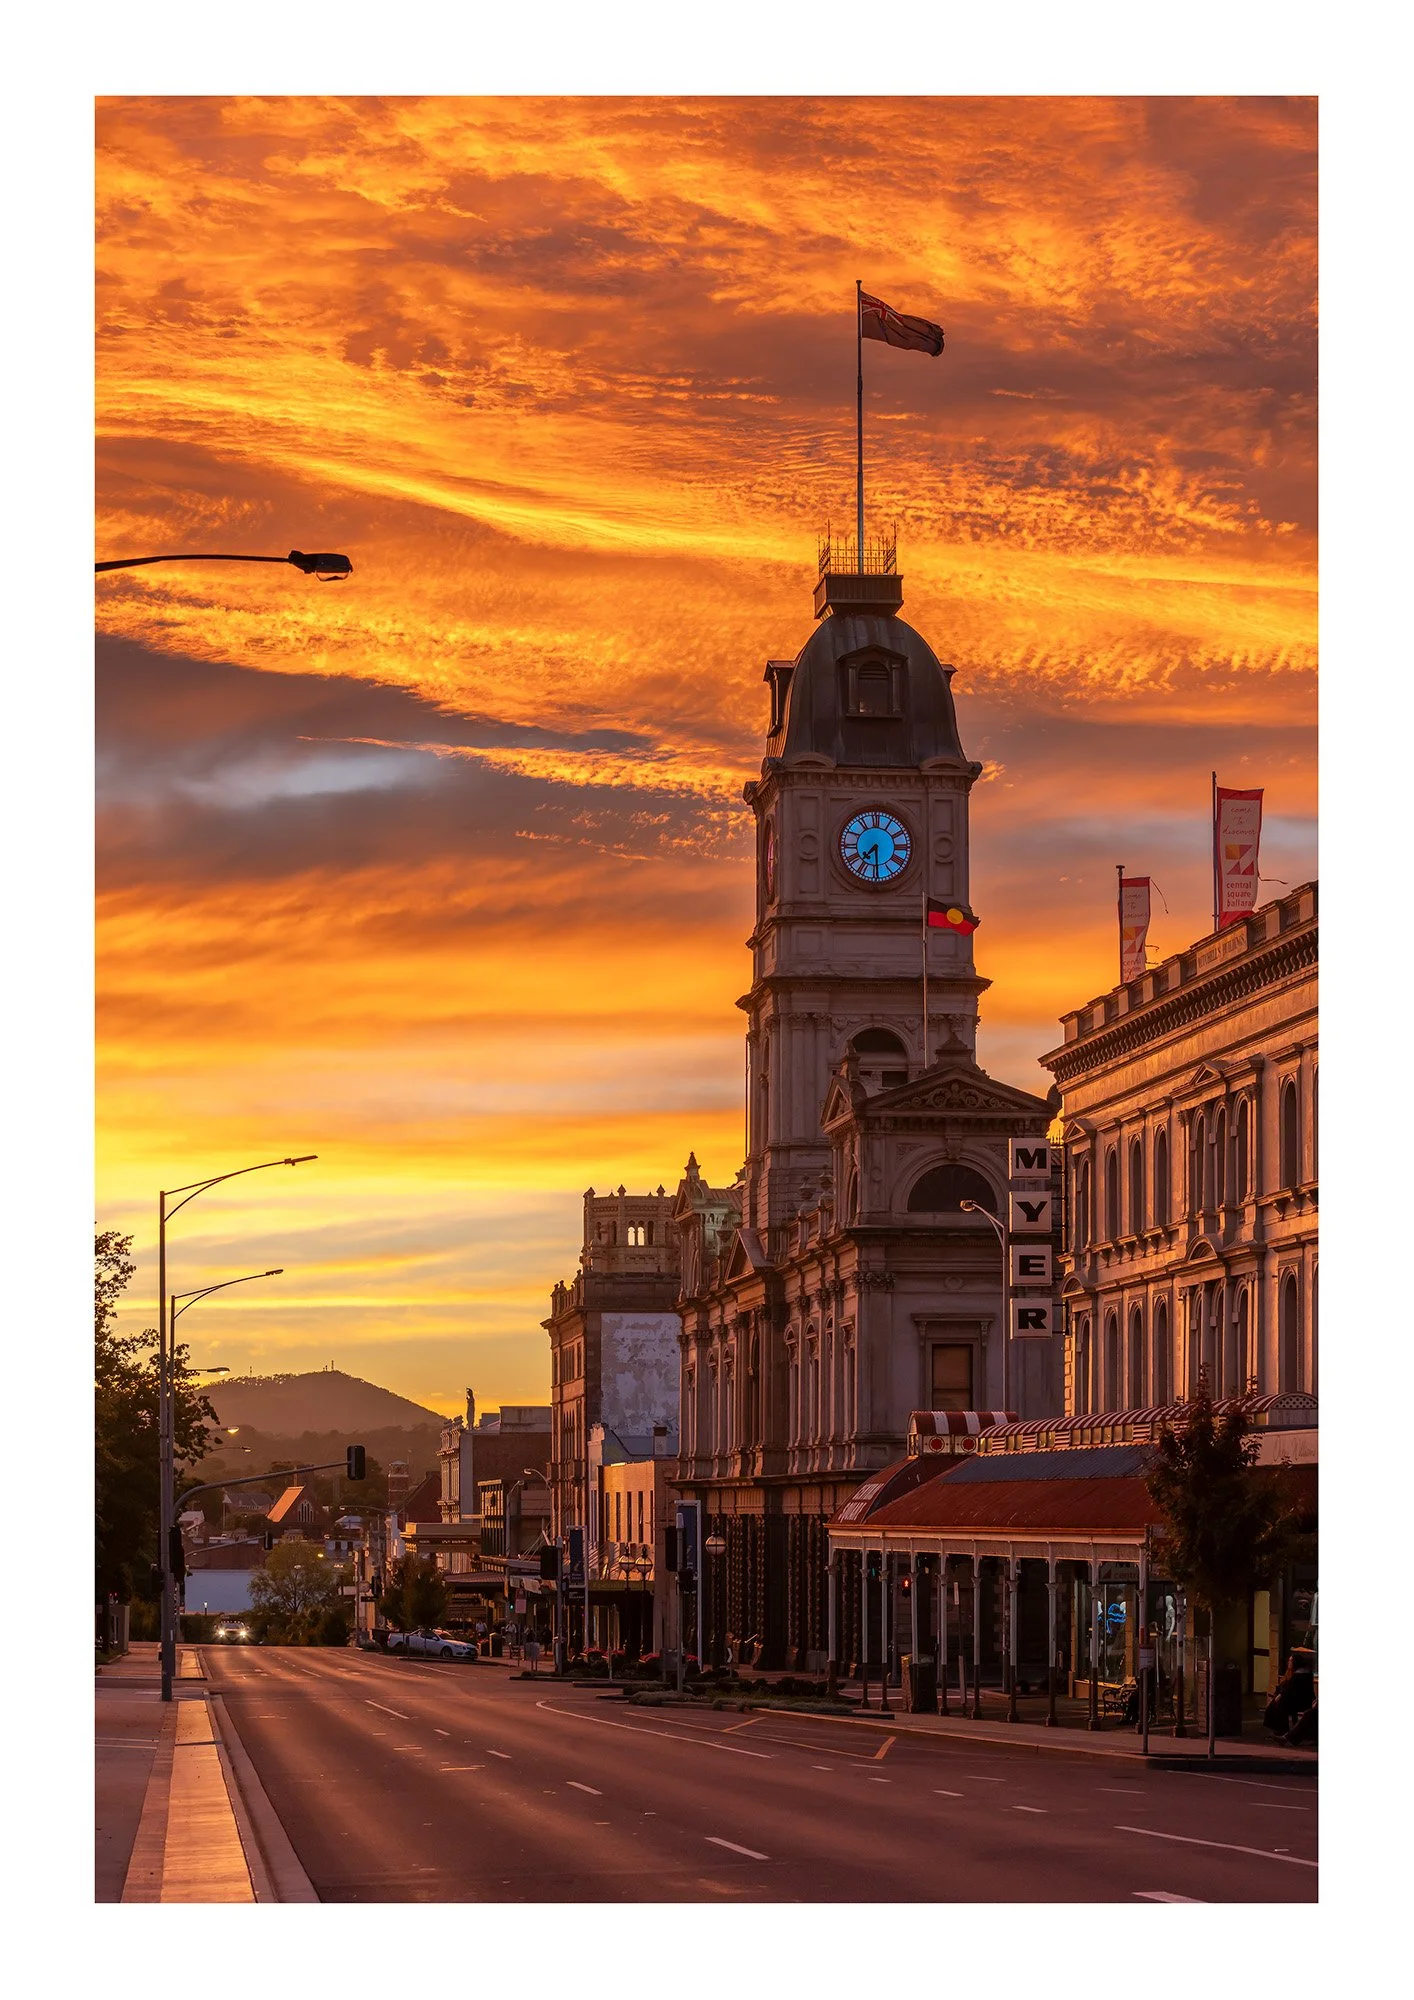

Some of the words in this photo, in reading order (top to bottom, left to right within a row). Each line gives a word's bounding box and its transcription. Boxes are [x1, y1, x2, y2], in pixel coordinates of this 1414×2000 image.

[1222, 824, 1257, 835] discover
[1226, 881, 1252, 889] central
[1227, 890, 1252, 899] square
[1015, 1147, 1048, 1330] MYER
